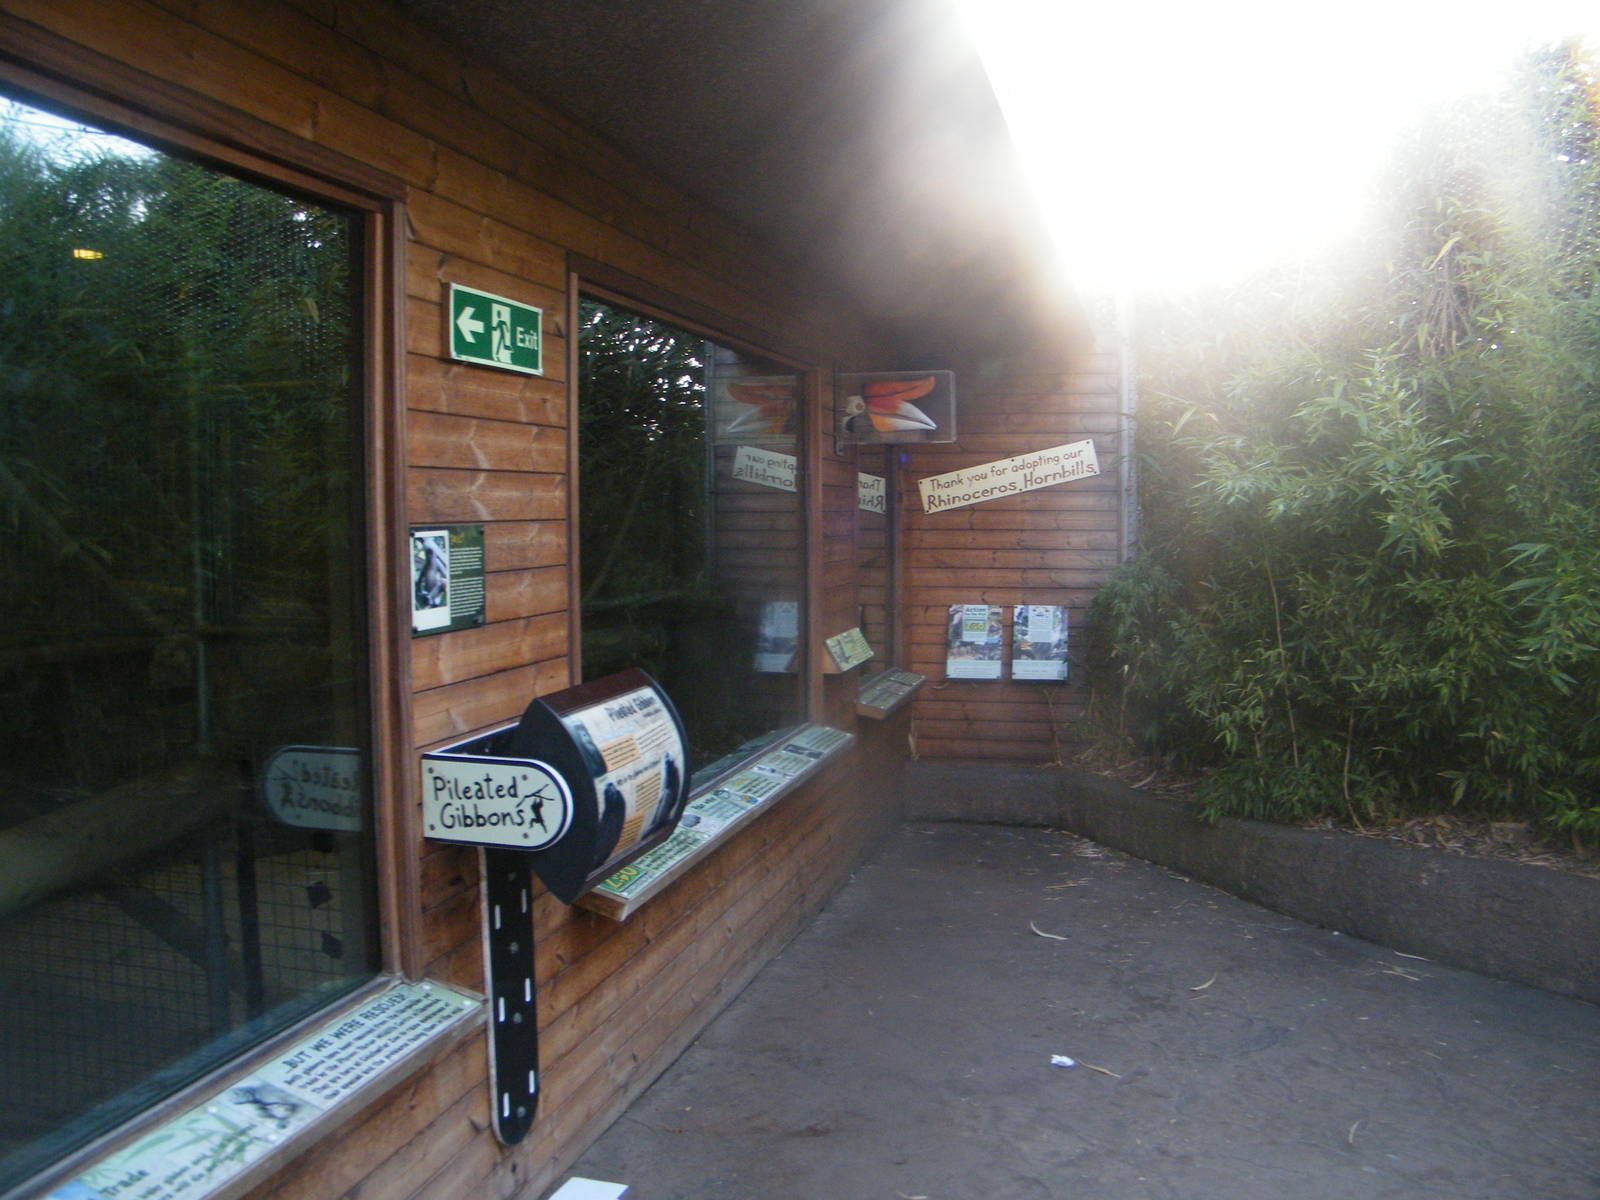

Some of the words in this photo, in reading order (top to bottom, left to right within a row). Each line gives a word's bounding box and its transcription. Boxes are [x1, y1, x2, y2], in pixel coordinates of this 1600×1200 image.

[516, 326, 538, 350] Exit
[927, 481, 1018, 511] Rhinoceros
[1023, 460, 1096, 488] Hornbills
[930, 474, 964, 492] Thank
[967, 472, 988, 487] you
[990, 466, 1009, 477] for
[1011, 454, 1060, 473] adopting
[1063, 449, 1084, 462] our
[433, 773, 519, 801] Pileated
[440, 803, 525, 829] Gibbons
[309, 1038, 333, 1052] WE
[328, 1019, 365, 1039] WERE
[98, 1167, 149, 1199] Trade
